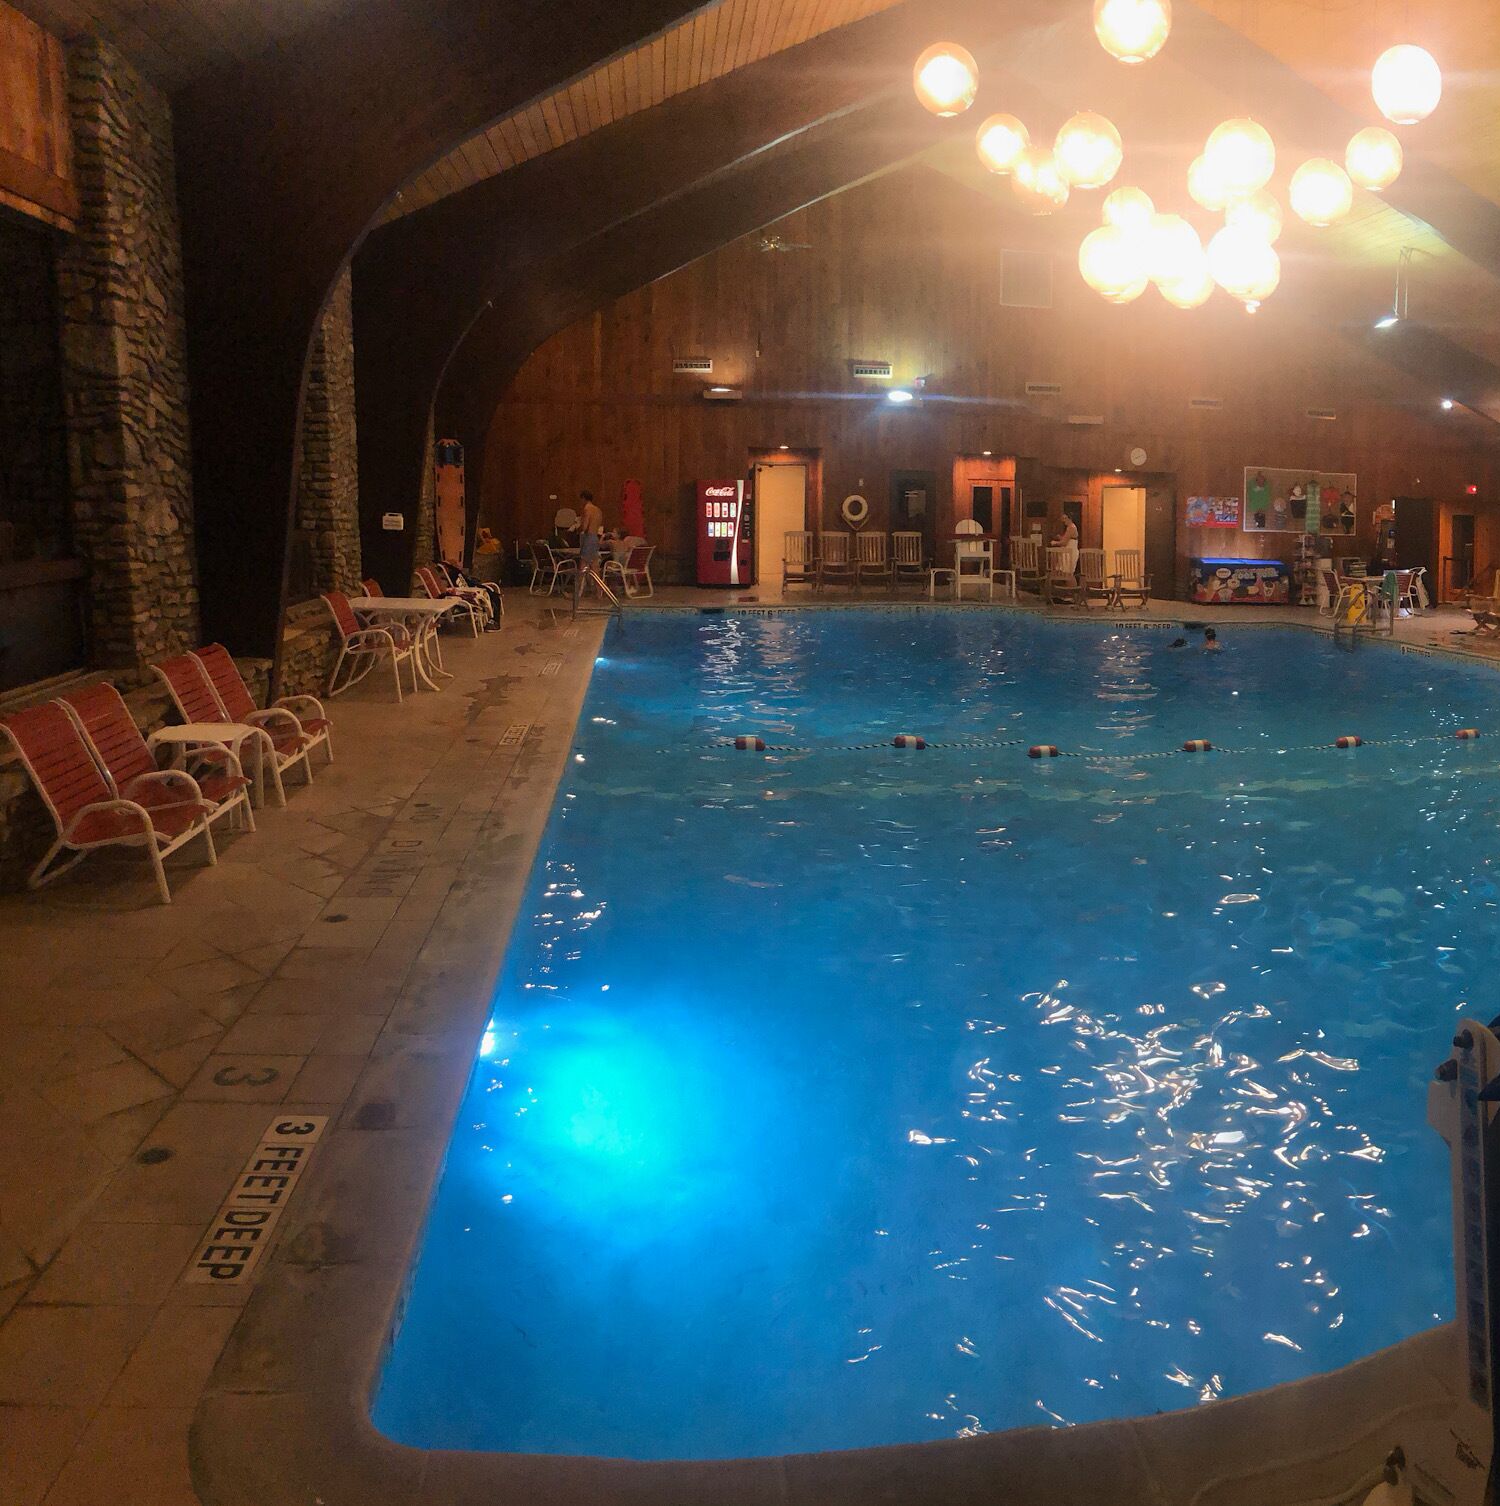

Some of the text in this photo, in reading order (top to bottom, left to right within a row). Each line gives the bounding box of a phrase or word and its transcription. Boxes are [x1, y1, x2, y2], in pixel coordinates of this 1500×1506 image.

[212, 1065, 281, 1088] 3
[196, 1121, 316, 1281] 3 FEET DEEP
